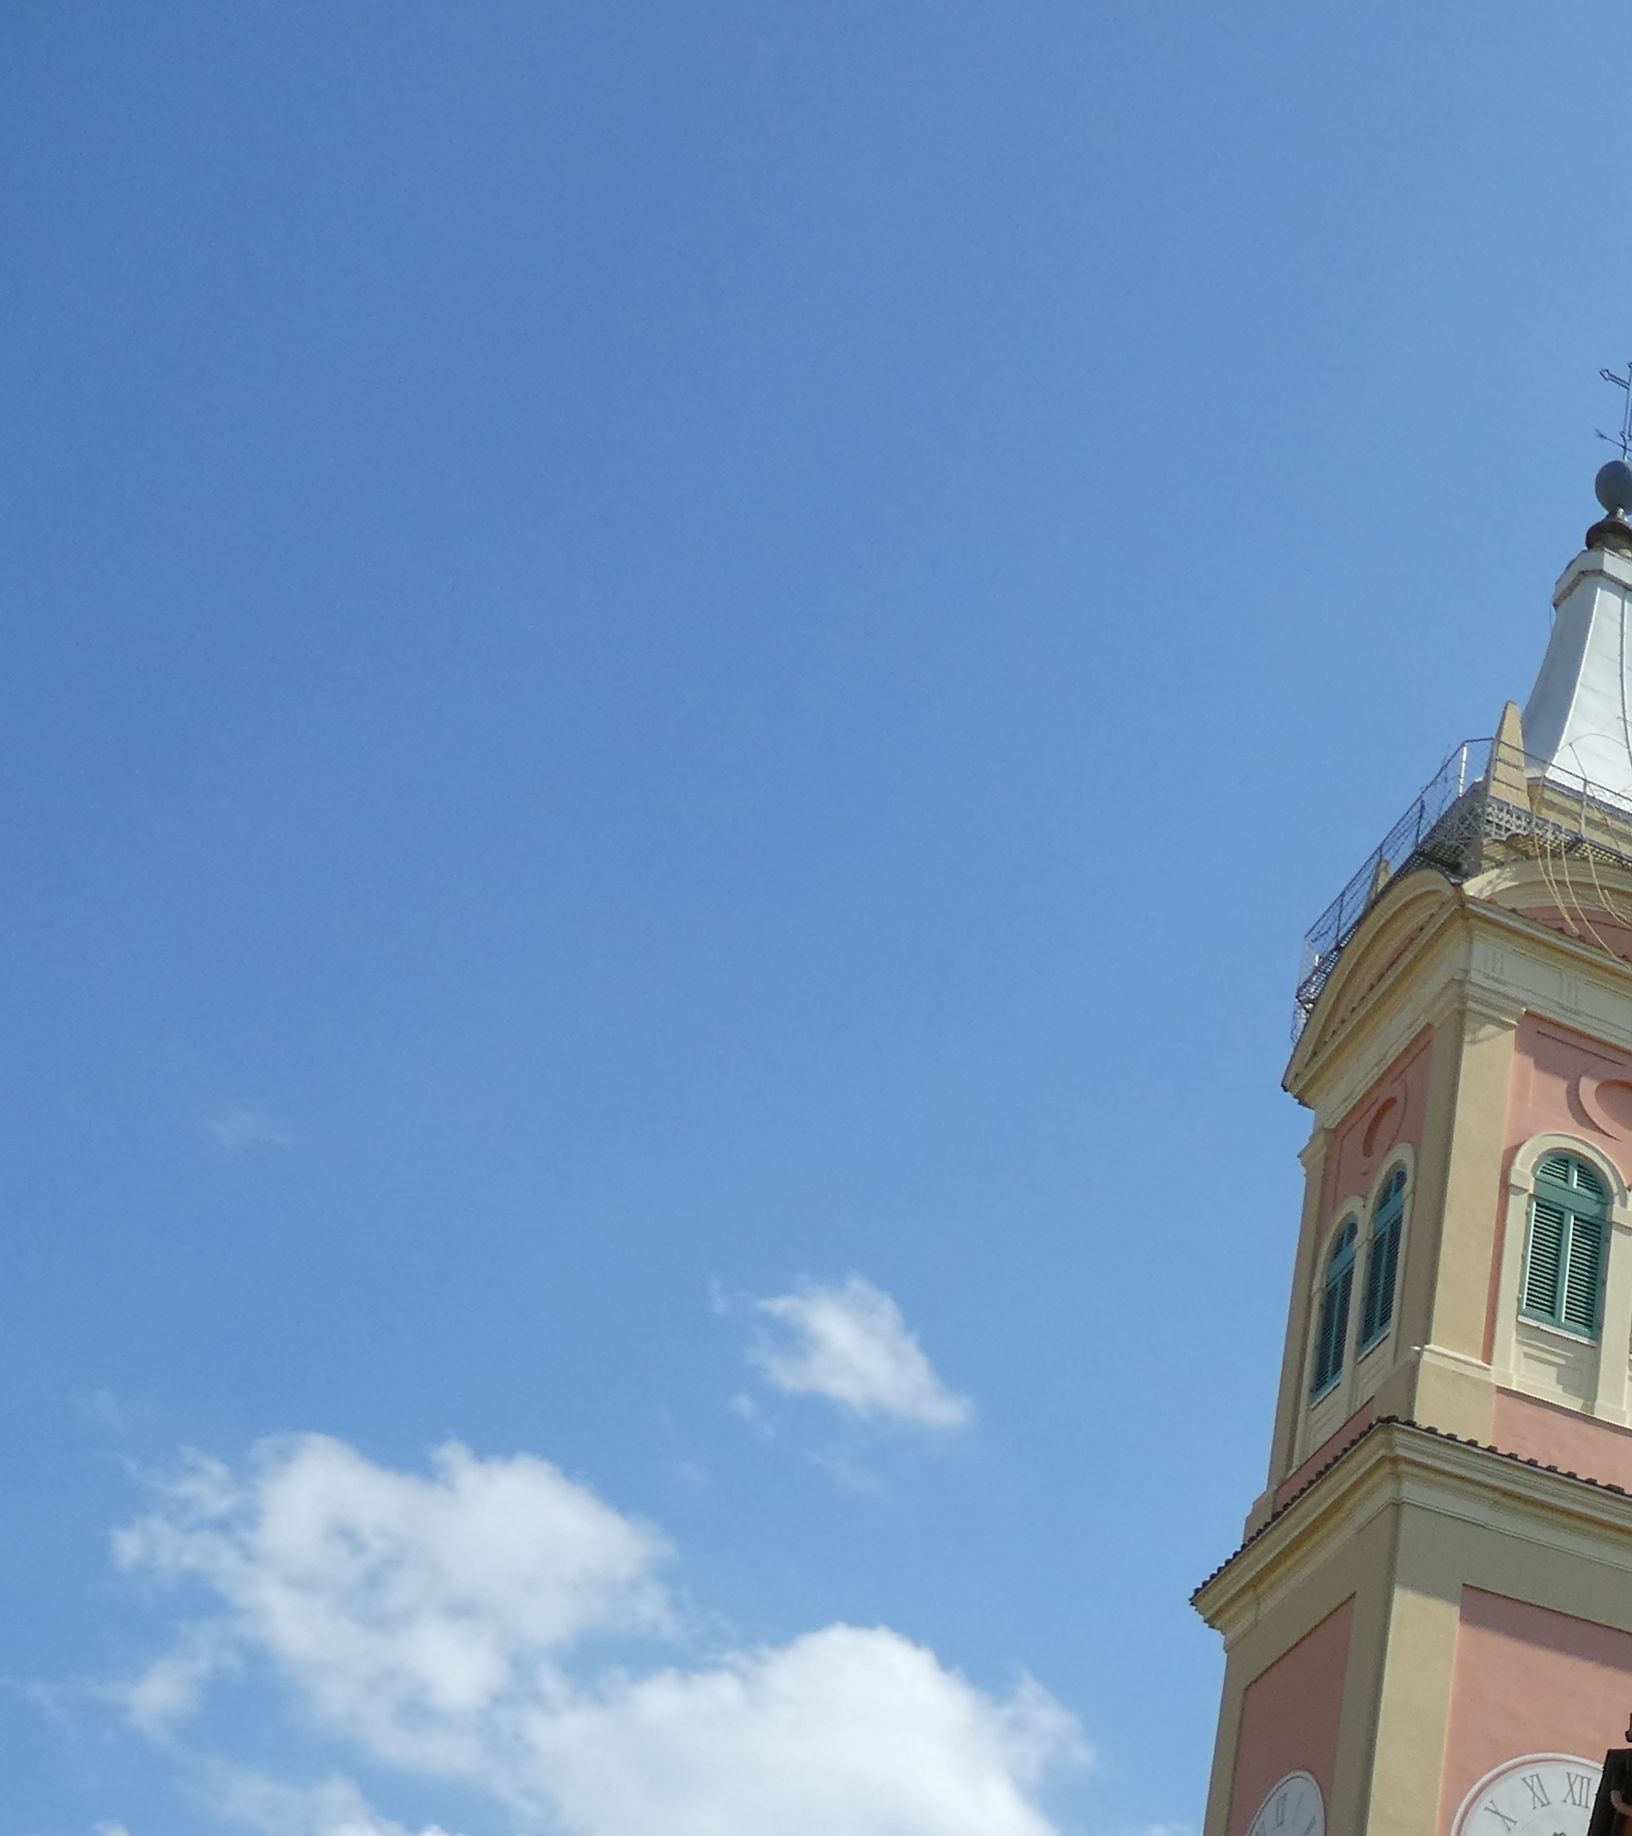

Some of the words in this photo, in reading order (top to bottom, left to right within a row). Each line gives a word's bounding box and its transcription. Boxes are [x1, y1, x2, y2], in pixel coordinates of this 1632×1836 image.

[1521, 1773, 1552, 1810] XI
[1562, 1771, 1593, 1809] XII
[1483, 1799, 1518, 1832] X
